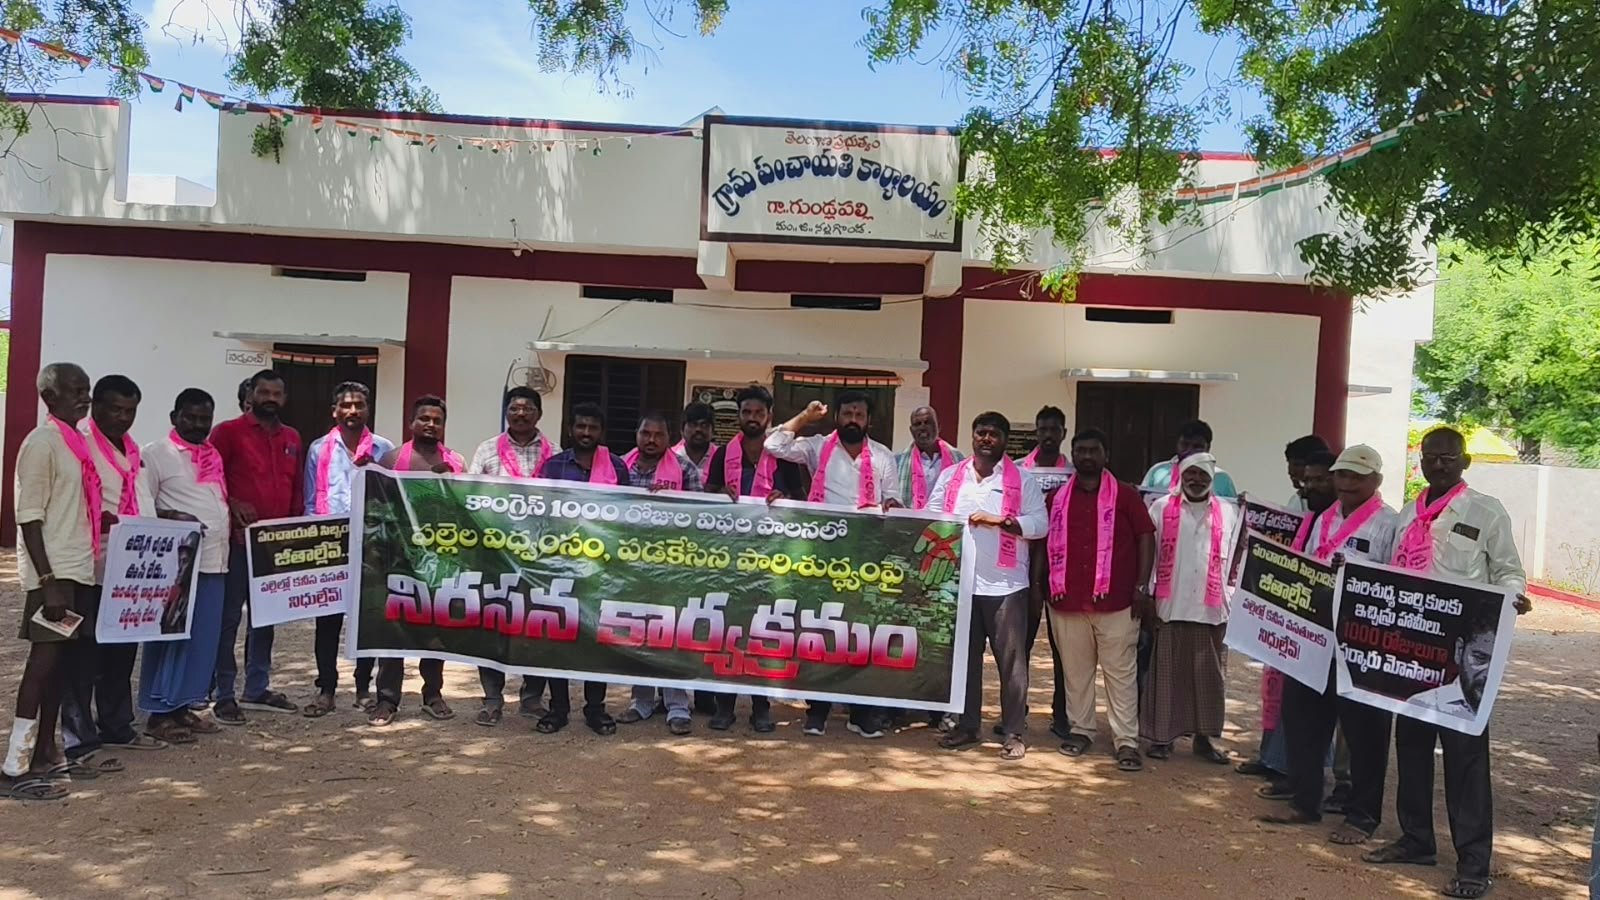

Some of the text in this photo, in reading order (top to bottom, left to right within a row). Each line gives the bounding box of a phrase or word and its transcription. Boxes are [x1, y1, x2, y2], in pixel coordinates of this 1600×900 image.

[712, 168, 757, 217] గ్రామ
[857, 157, 948, 218] కార్యాలయం
[465, 494, 848, 541] కాంగ్రెస్ 1000 రోజుల విఫల పాలనలో
[320, 571, 349, 583] వసతు
[411, 522, 478, 555] పల్లెల
[617, 536, 730, 569] పడకేసిన
[736, 548, 904, 593] పారిశుద్ధ్యంపై
[384, 571, 919, 680] నిరసన కార్యక్రమం
